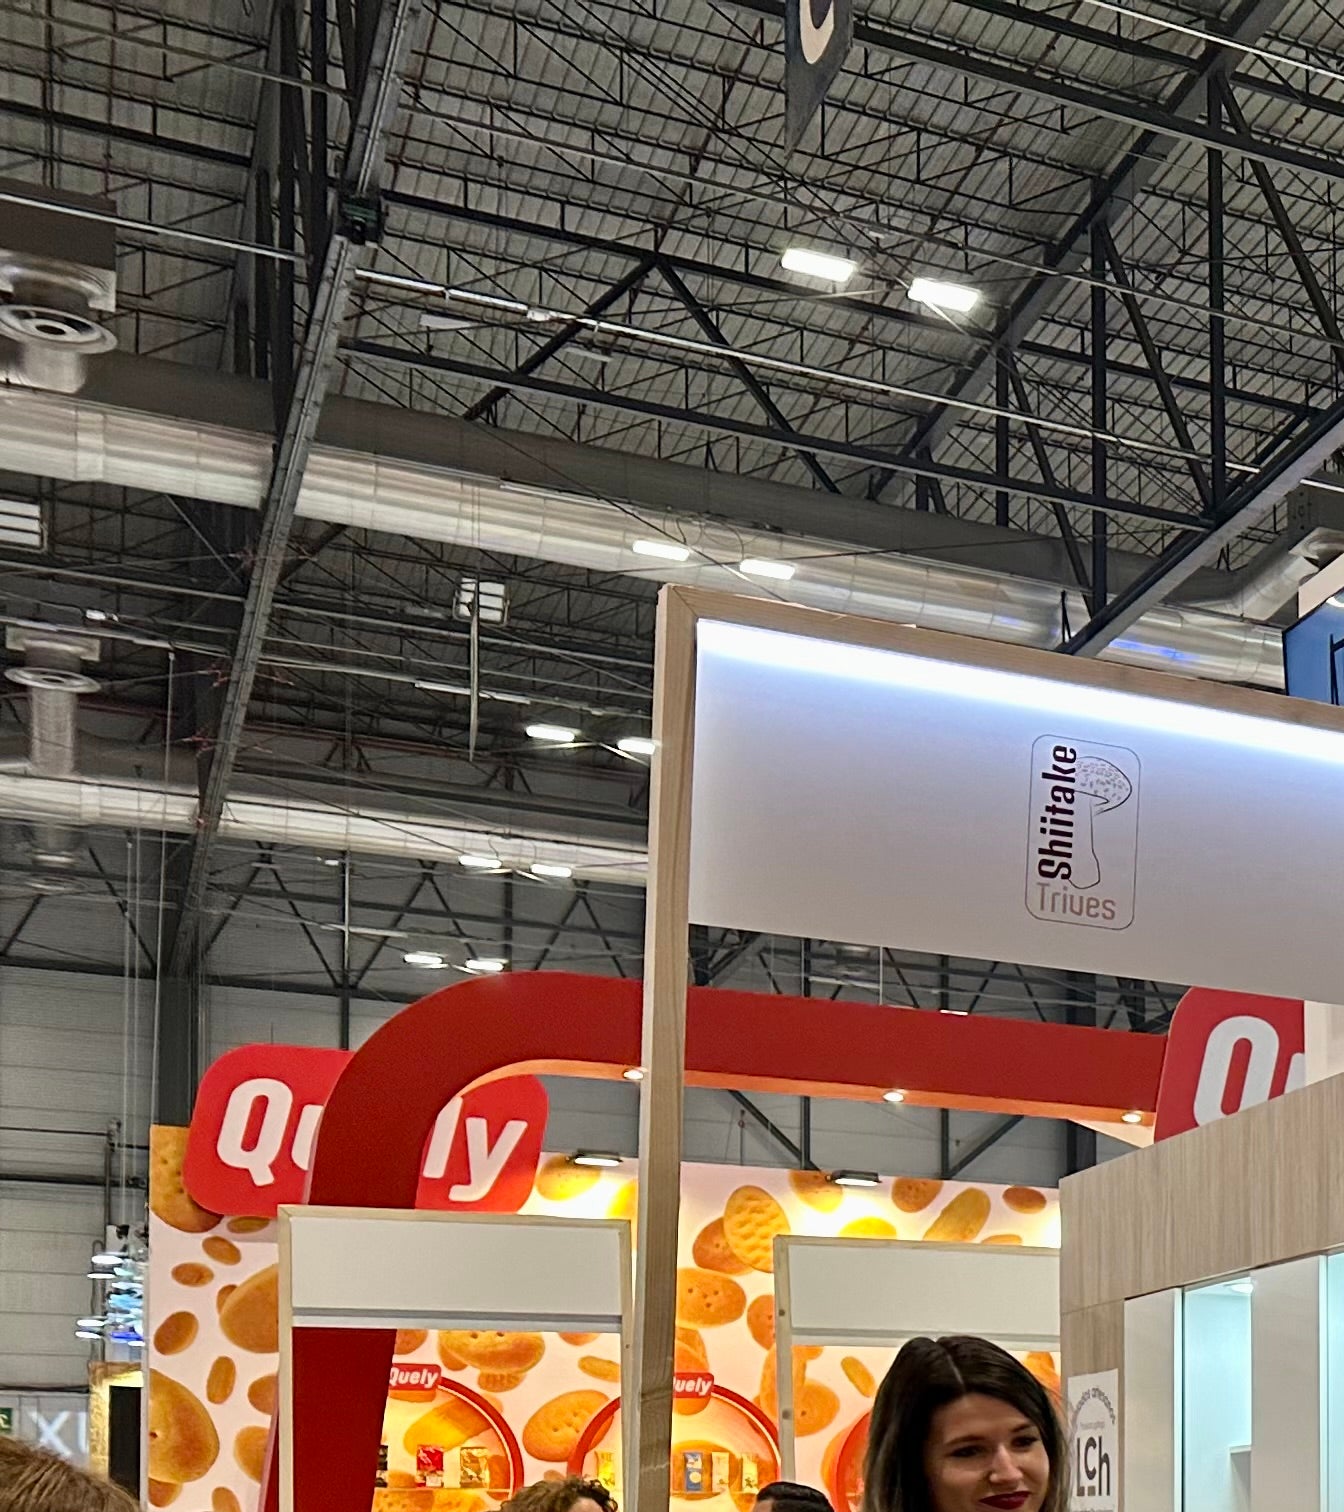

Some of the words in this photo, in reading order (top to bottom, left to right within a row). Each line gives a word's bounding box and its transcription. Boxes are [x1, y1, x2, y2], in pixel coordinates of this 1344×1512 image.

[1037, 744, 1077, 881] Shiitake
[216, 1077, 529, 1202] Qly
[389, 1366, 439, 1389] Quely
[673, 1376, 713, 1397] uely
